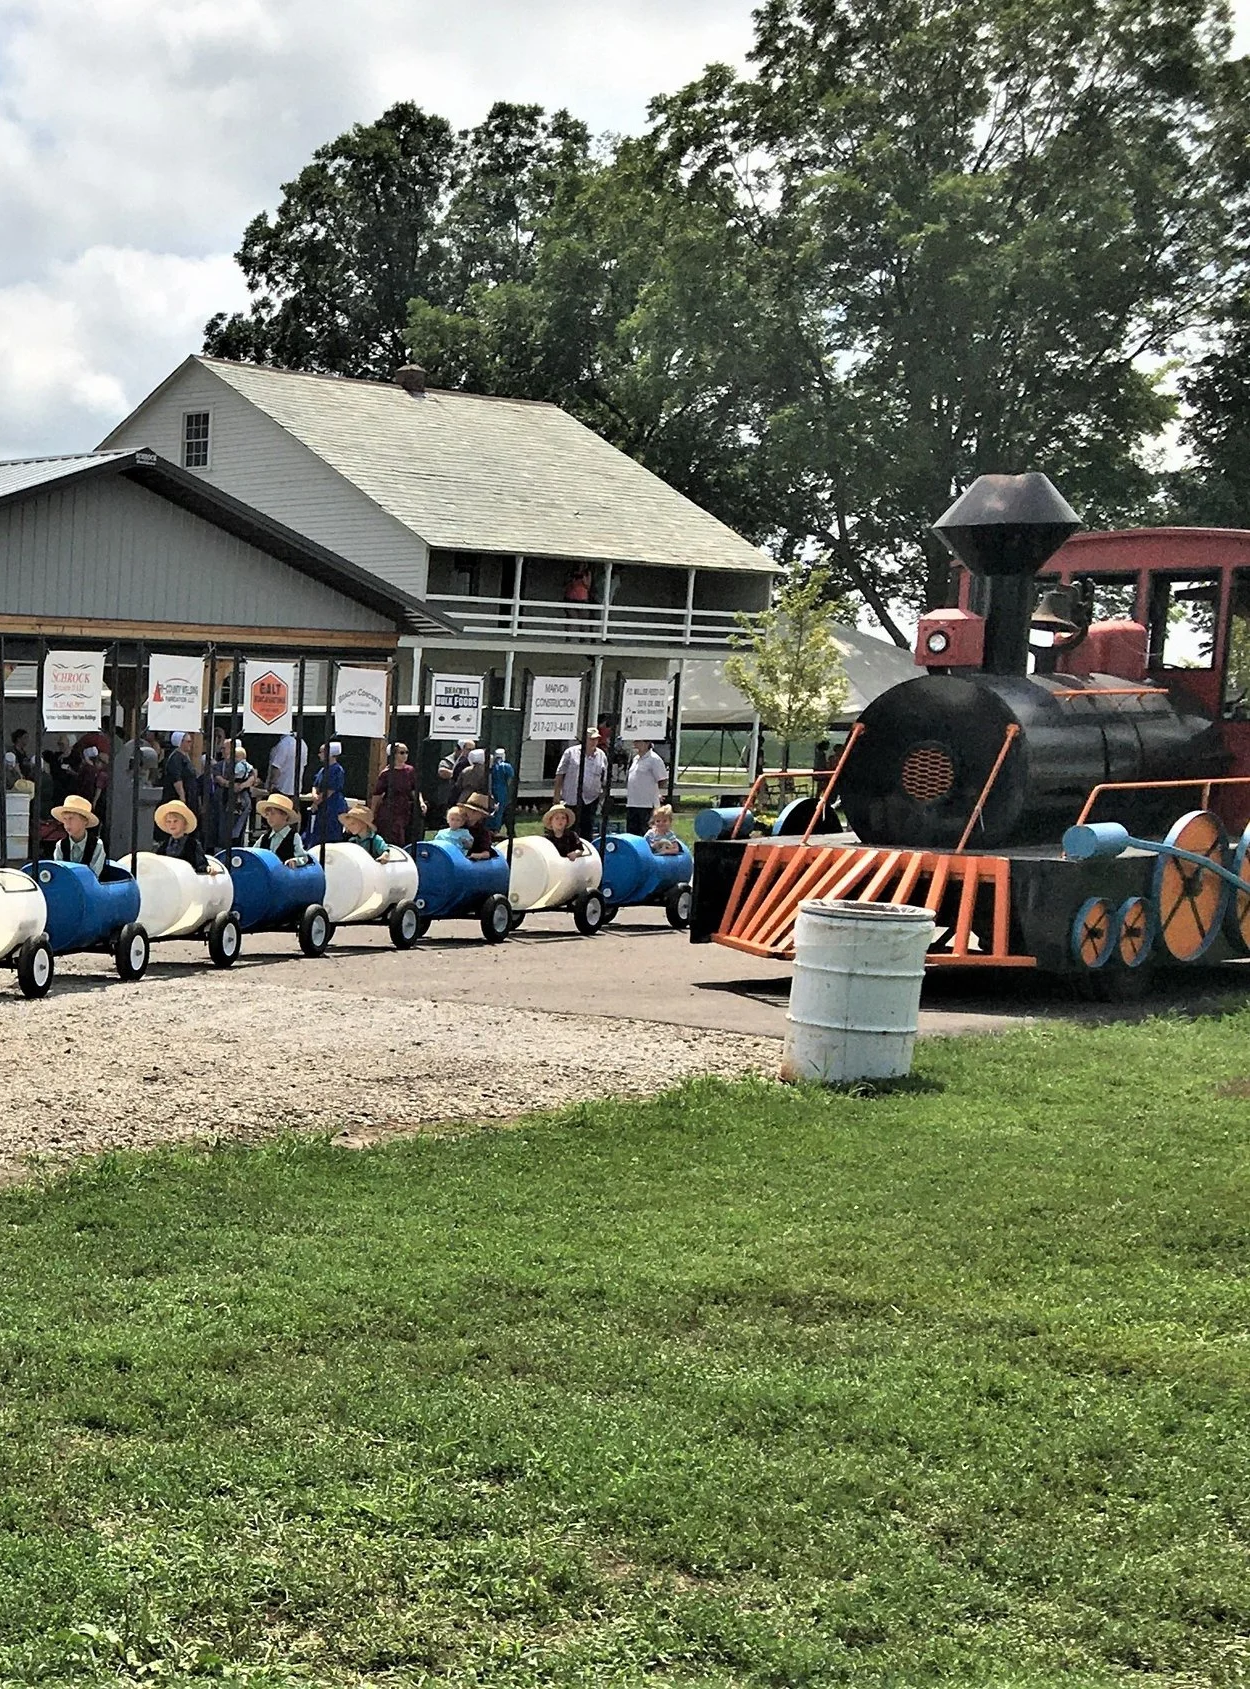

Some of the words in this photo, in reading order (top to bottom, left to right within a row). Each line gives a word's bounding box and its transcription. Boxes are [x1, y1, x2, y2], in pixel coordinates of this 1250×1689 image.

[52, 669, 91, 684] SCHROCK
[357, 688, 383, 707] CONCRETE
[436, 696, 453, 706] BULK
[453, 696, 478, 707] FOODS
[535, 698, 576, 708] CONSTRUCTION
